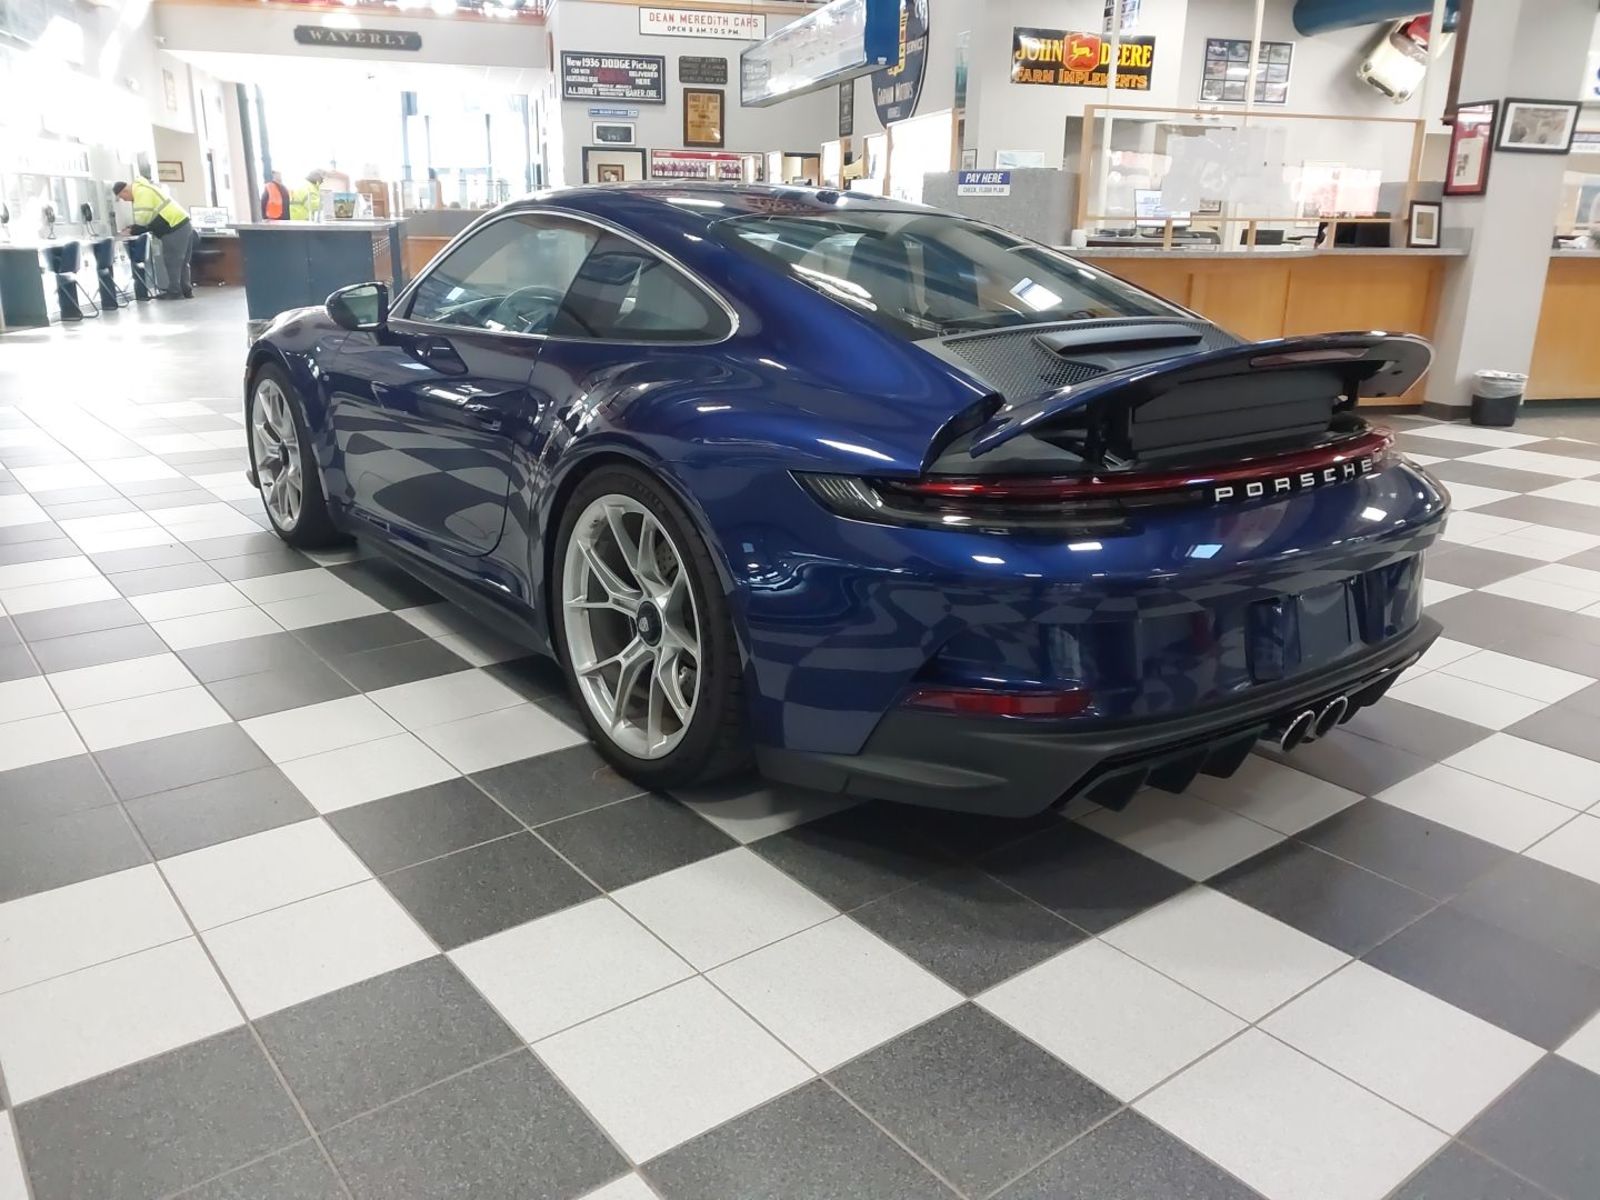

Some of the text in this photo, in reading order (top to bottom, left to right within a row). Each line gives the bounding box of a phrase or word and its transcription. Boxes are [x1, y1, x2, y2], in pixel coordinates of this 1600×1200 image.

[649, 12, 675, 23] DEAN
[734, 17, 759, 28] CARS
[309, 30, 408, 45] WAVERLY
[1015, 37, 1064, 61] JOHN
[566, 57, 658, 71] New 1936 DODGE Pickup
[1016, 66, 1055, 83] FARM
[965, 172, 1004, 183] PAY HERE
[1215, 458, 1373, 502] PORSCHE
